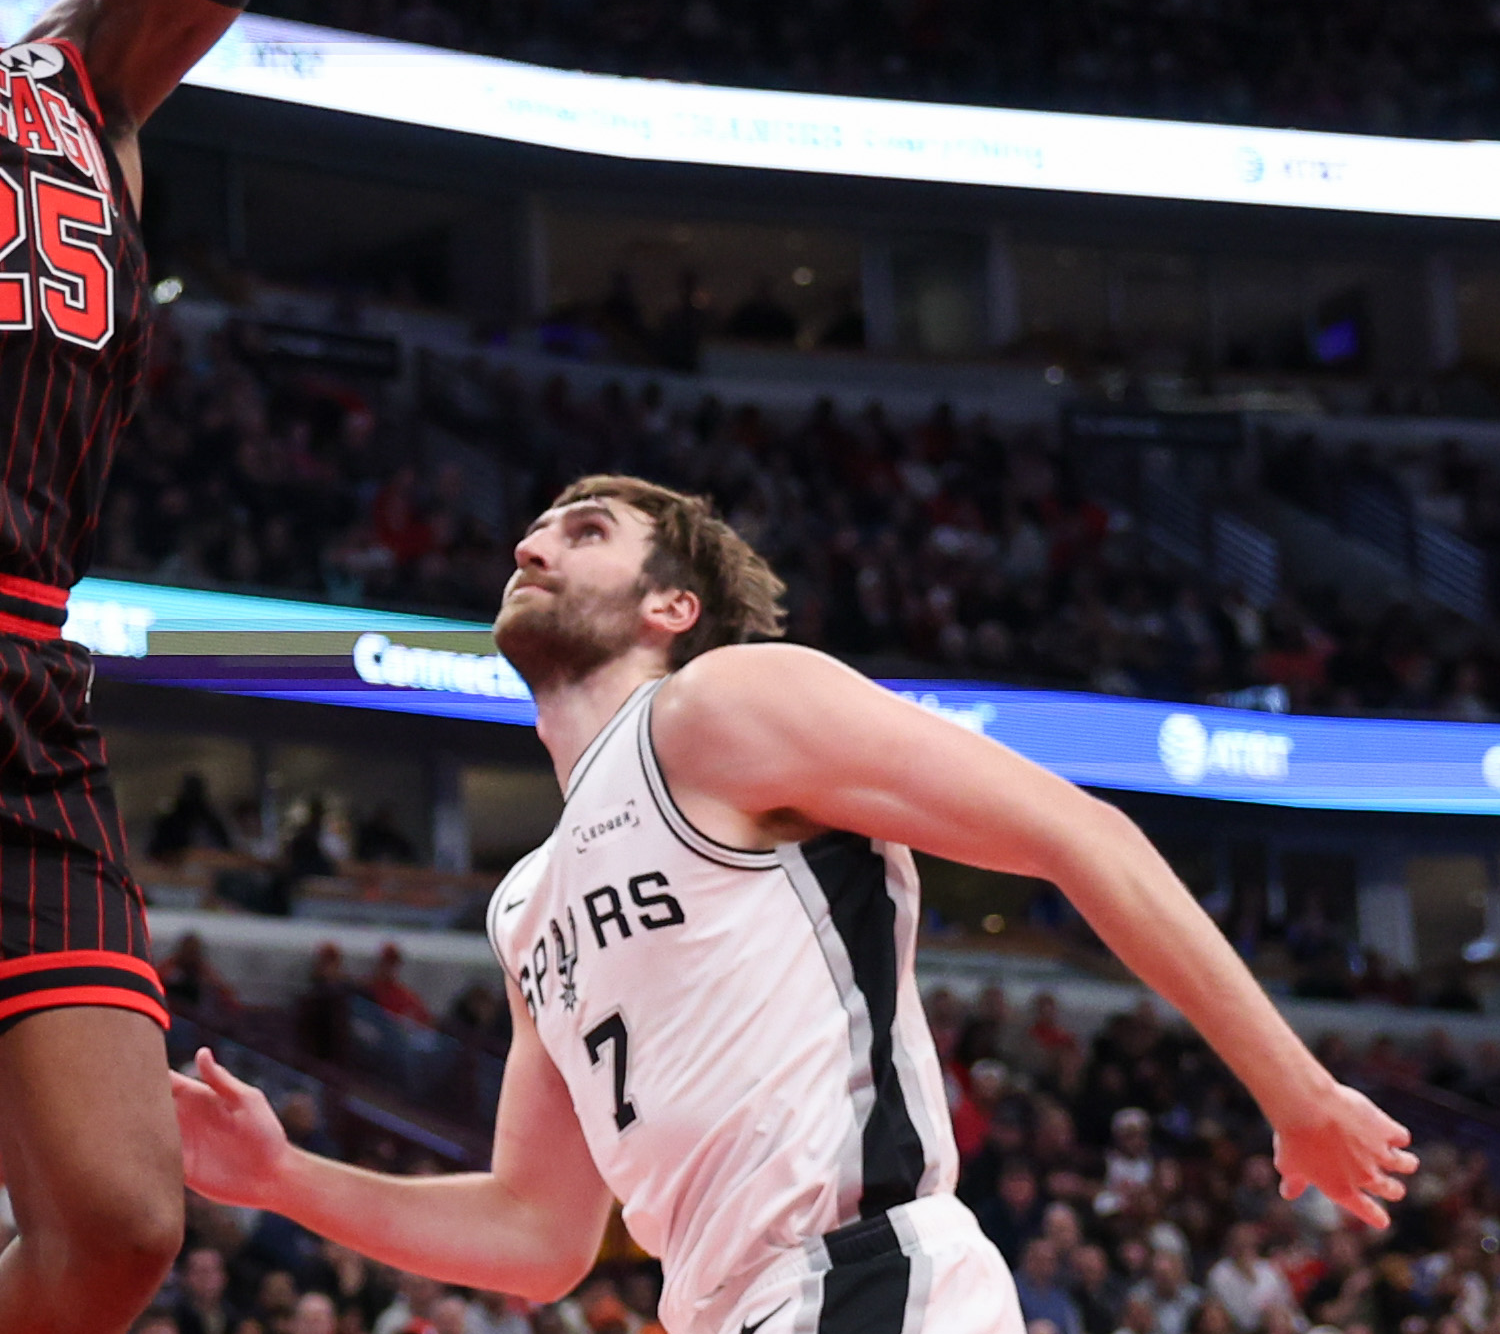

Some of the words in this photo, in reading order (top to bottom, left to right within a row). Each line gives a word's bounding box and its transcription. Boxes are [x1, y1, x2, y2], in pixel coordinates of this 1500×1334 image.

[580, 810, 632, 844] LEDGER
[519, 871, 686, 1024] SPURS
[583, 1009, 638, 1134] 7
